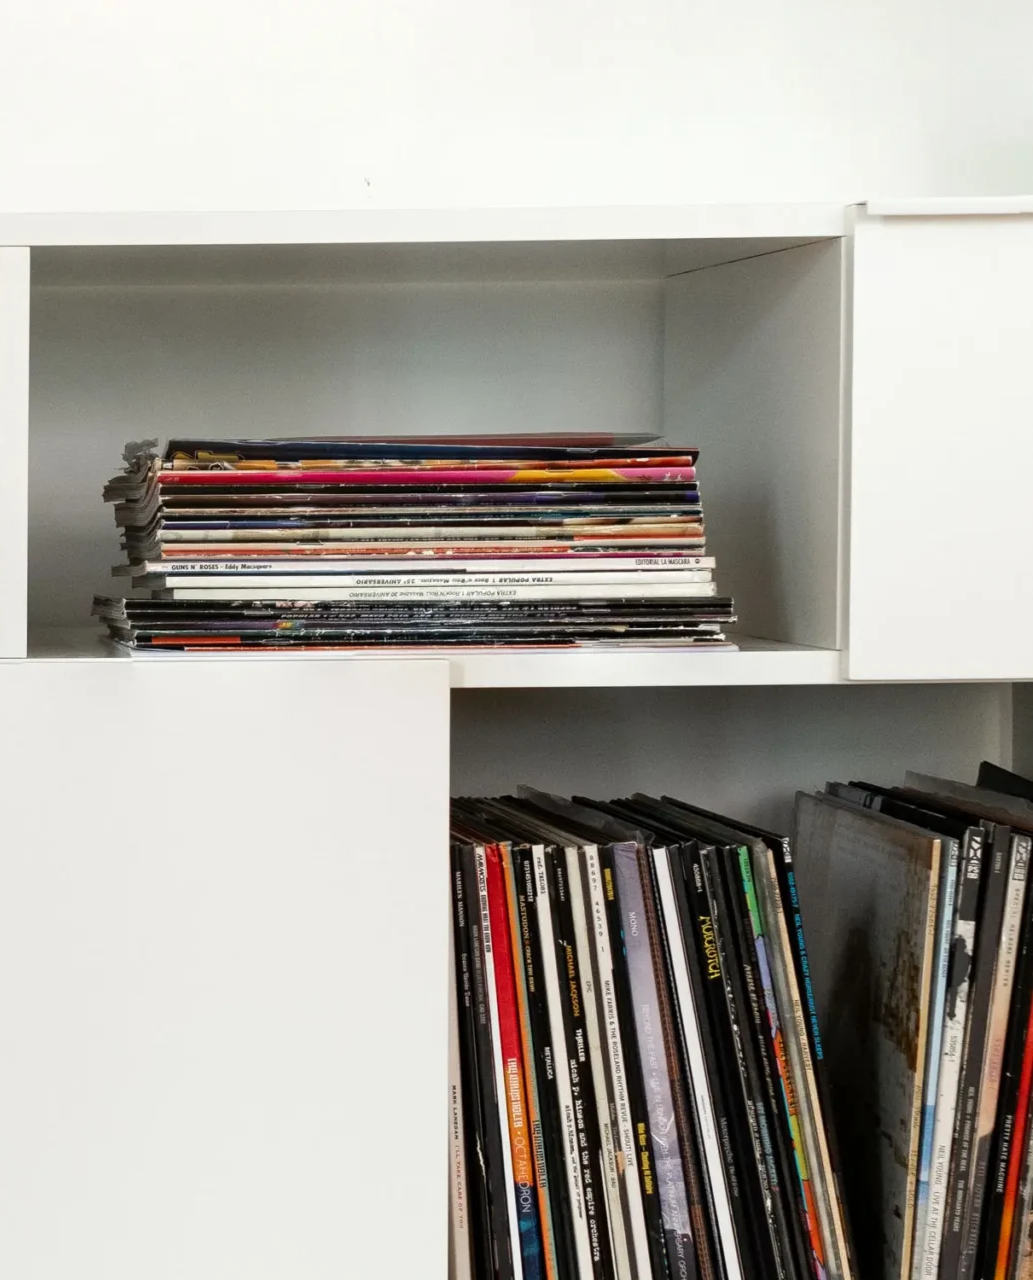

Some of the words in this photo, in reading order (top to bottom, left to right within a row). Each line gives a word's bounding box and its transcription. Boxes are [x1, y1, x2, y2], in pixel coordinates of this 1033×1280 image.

[635, 558, 660, 566] EDITORIAL
[661, 558, 667, 566] LA
[629, 912, 638, 936] MONO
[698, 916, 721, 979] MUDCRUTCH
[566, 946, 575, 978] MICHAEL
[570, 981, 580, 1016] JACKSON
[604, 981, 613, 996] MIKE
[606, 998, 615, 1019] FARRIS
[576, 1029, 585, 1062] THRILLER
[610, 1028, 618, 1039] THE
[544, 1047, 554, 1079] METALLICA
[612, 1042, 622, 1074] ROSELAND
[616, 1076, 626, 1101] RHYTHM
[620, 1103, 628, 1122] REVUE
[623, 1129, 632, 1152] SHOUT!
[514, 1137, 531, 1212] OCTAHEDRON
